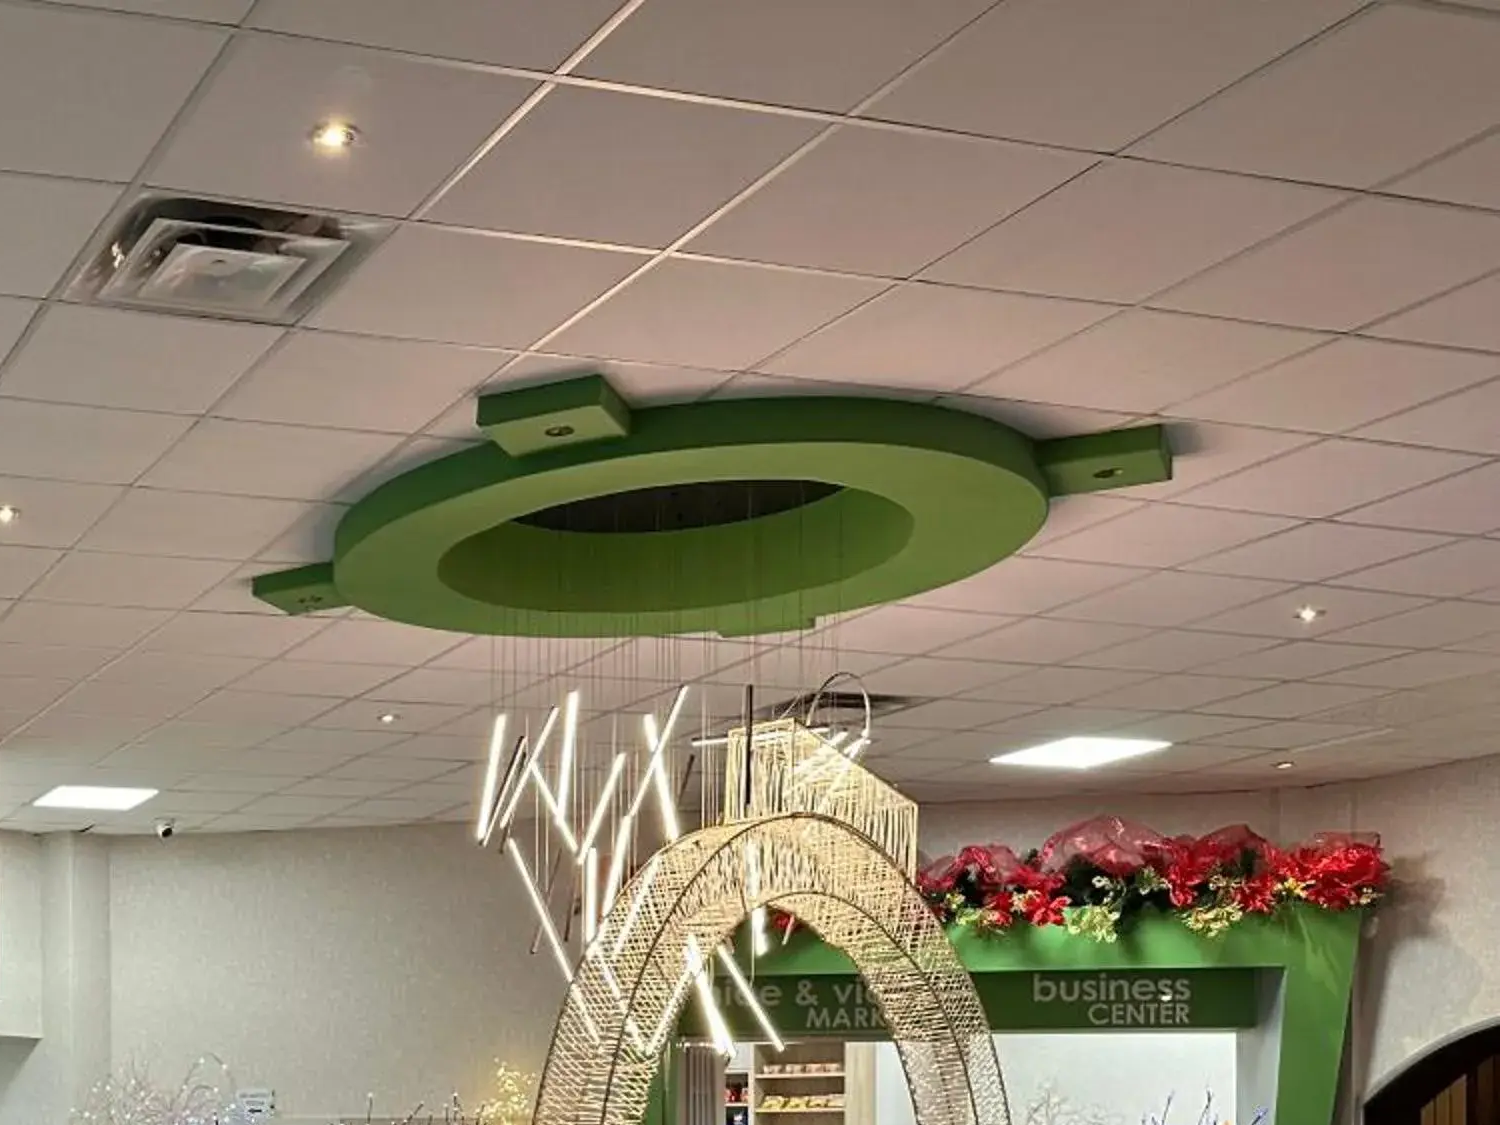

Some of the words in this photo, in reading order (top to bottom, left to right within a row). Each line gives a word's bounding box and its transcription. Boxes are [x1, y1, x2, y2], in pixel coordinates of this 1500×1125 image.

[795, 979, 818, 1006] &
[1033, 973, 1191, 1001] business
[806, 1007, 887, 1028] MARK
[1088, 1003, 1189, 1025] CENTER
